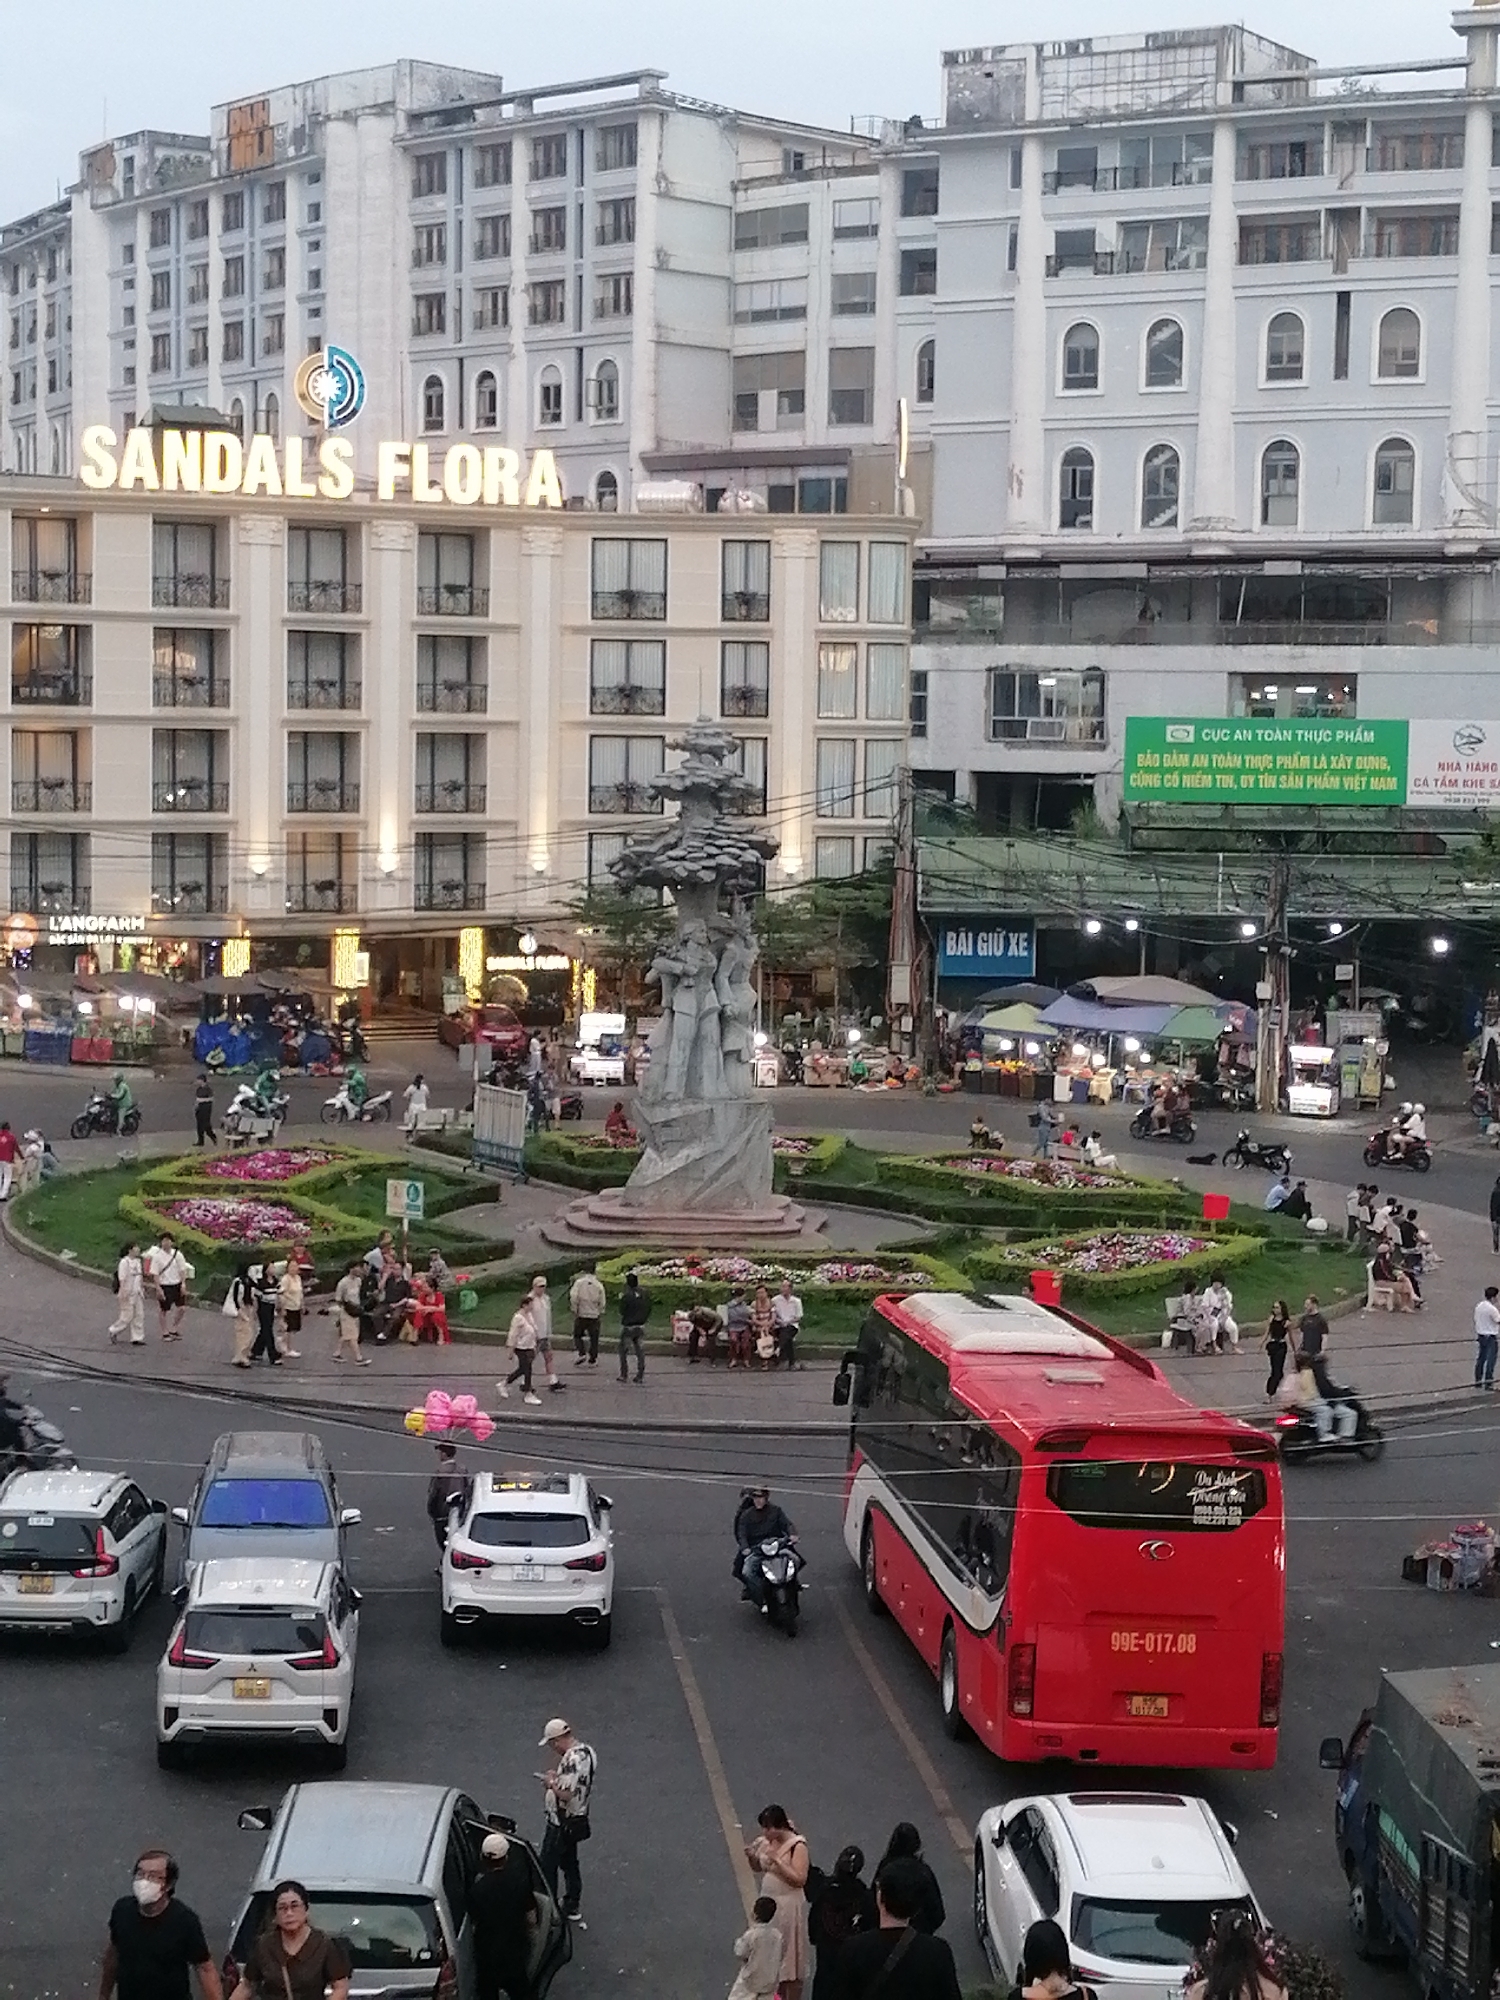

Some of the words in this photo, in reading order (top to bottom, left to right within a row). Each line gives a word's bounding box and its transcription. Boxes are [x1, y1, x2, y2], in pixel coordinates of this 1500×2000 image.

[79, 425, 355, 499] SANDALS
[378, 441, 563, 507] FLORA
[1202, 728, 1230, 743] CỤC
[1234, 729, 1252, 741] AN
[1256, 726, 1292, 741] TOÀN
[1295, 729, 1332, 744] THỰC
[1336, 724, 1374, 743] PHẨM
[1370, 777, 1397, 790] NAM
[49, 915, 145, 931] L'ANGFARM
[946, 927, 973, 956] BÃI
[977, 927, 1006, 957] GIỮ
[1007, 932, 1028, 957] XE
[1111, 1631, 1197, 1654] 99E-017.08
